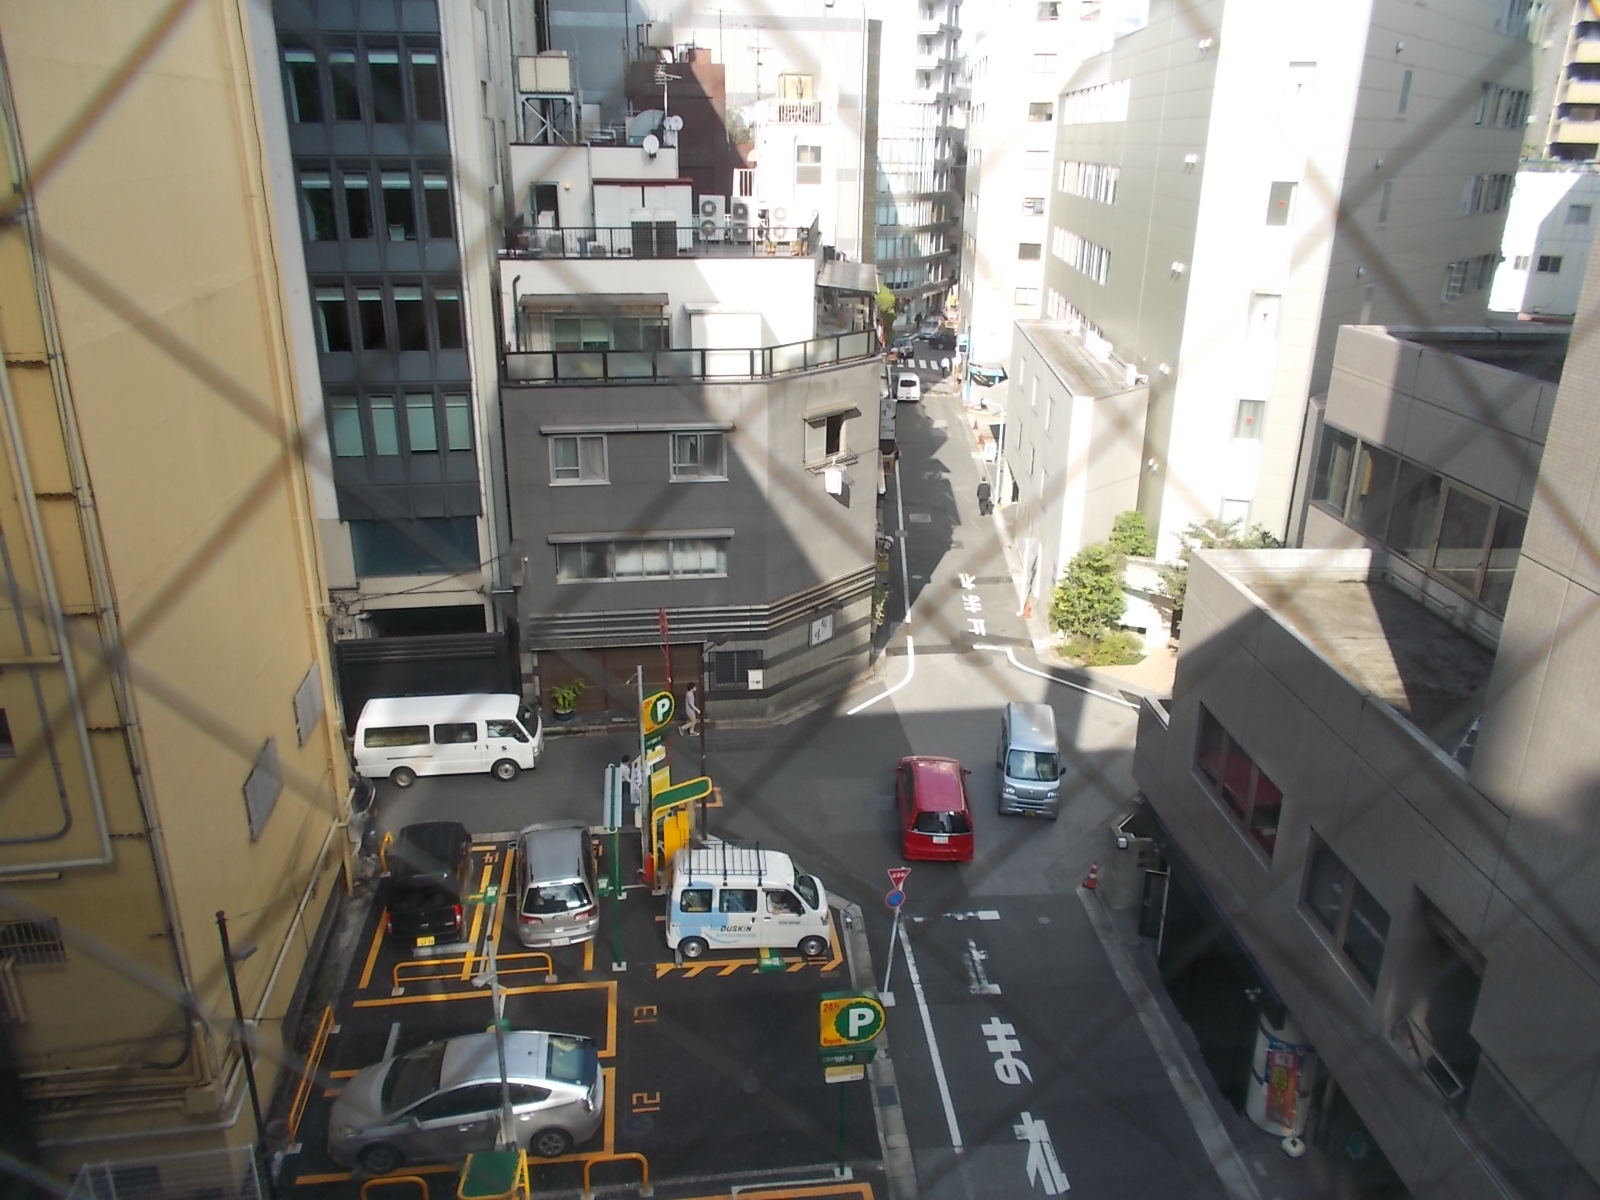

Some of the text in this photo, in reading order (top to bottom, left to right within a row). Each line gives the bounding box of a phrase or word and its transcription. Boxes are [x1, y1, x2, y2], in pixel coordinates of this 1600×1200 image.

[958, 573, 986, 636] 止まれ
[657, 698, 670, 722] P
[849, 1008, 874, 1037] P
[964, 938, 1071, 1195] 止まれ
[632, 1092, 660, 1113] 12
